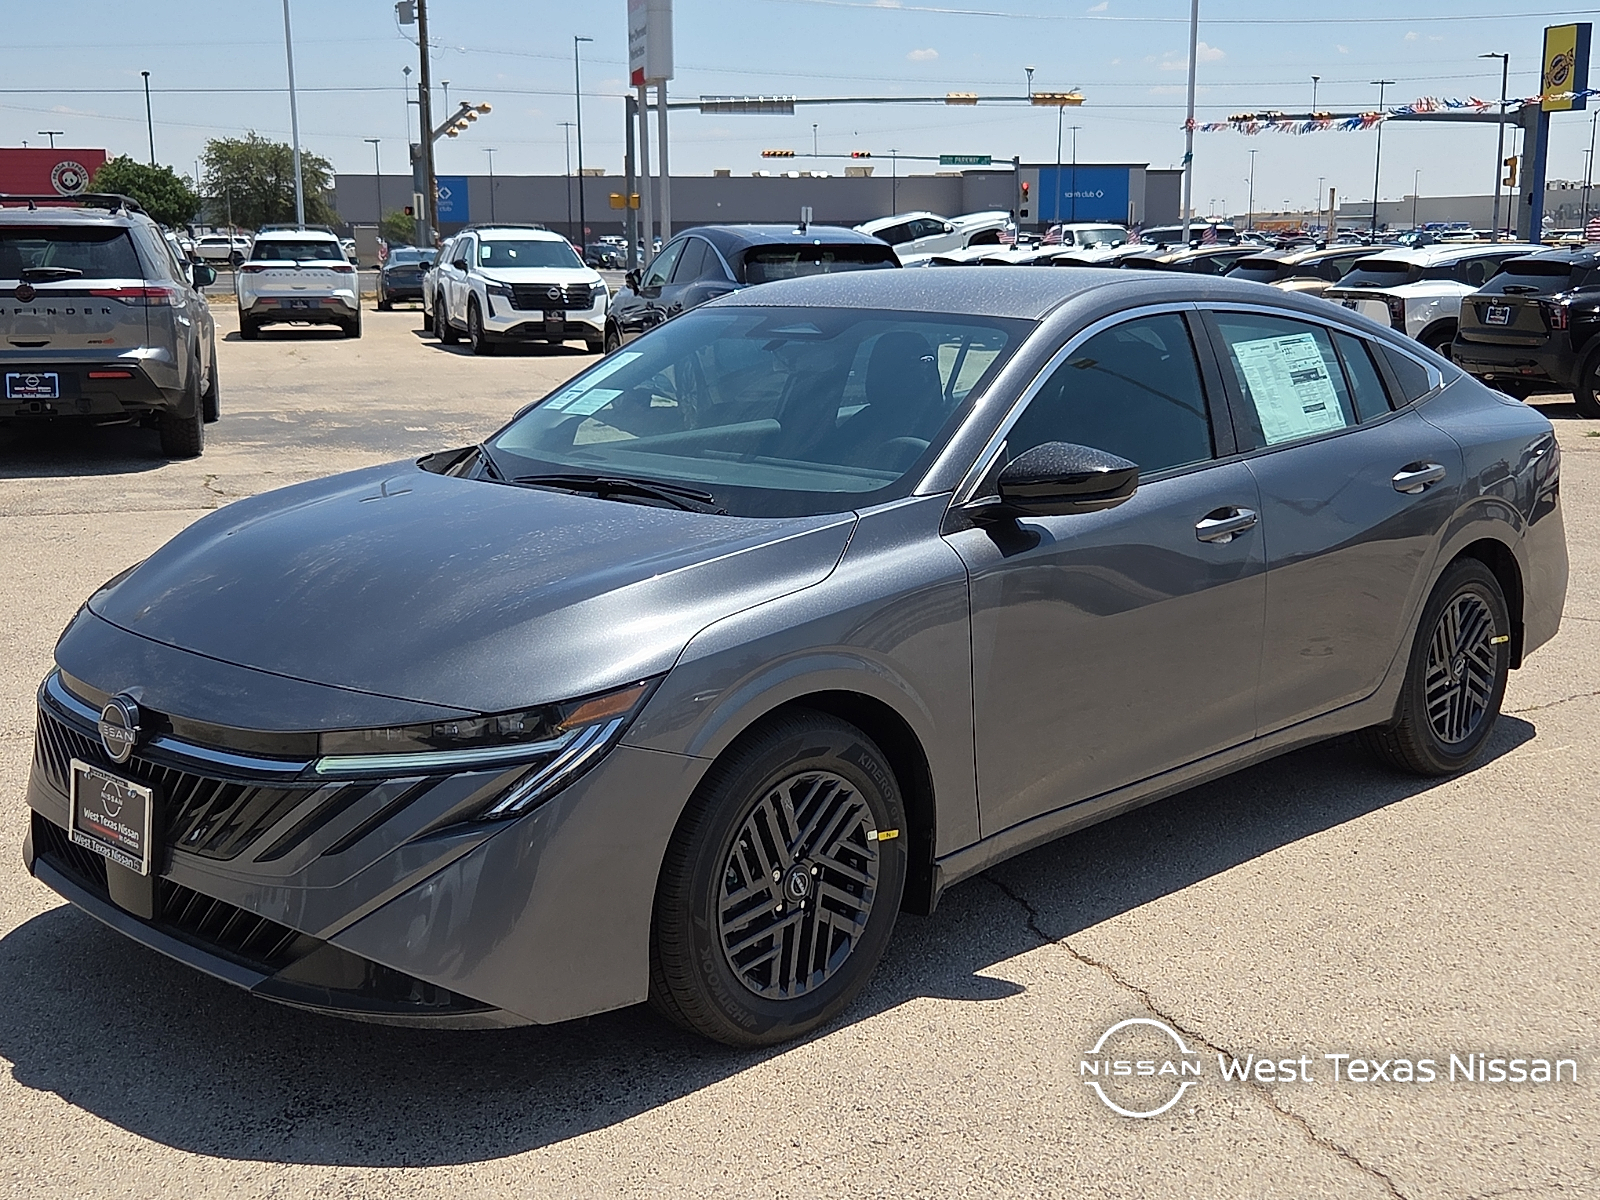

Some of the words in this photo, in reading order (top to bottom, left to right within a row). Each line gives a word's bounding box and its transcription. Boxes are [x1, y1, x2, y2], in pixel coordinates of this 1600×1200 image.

[52, 163, 66, 180] PANDA
[100, 723, 134, 742] SSAN
[101, 790, 123, 806] NISSAN
[83, 807, 100, 823] West
[100, 813, 118, 831] Texas
[118, 820, 140, 841] Nissan
[74, 832, 91, 849] West
[91, 840, 111, 857] Texas
[111, 849, 134, 868] Nissan
